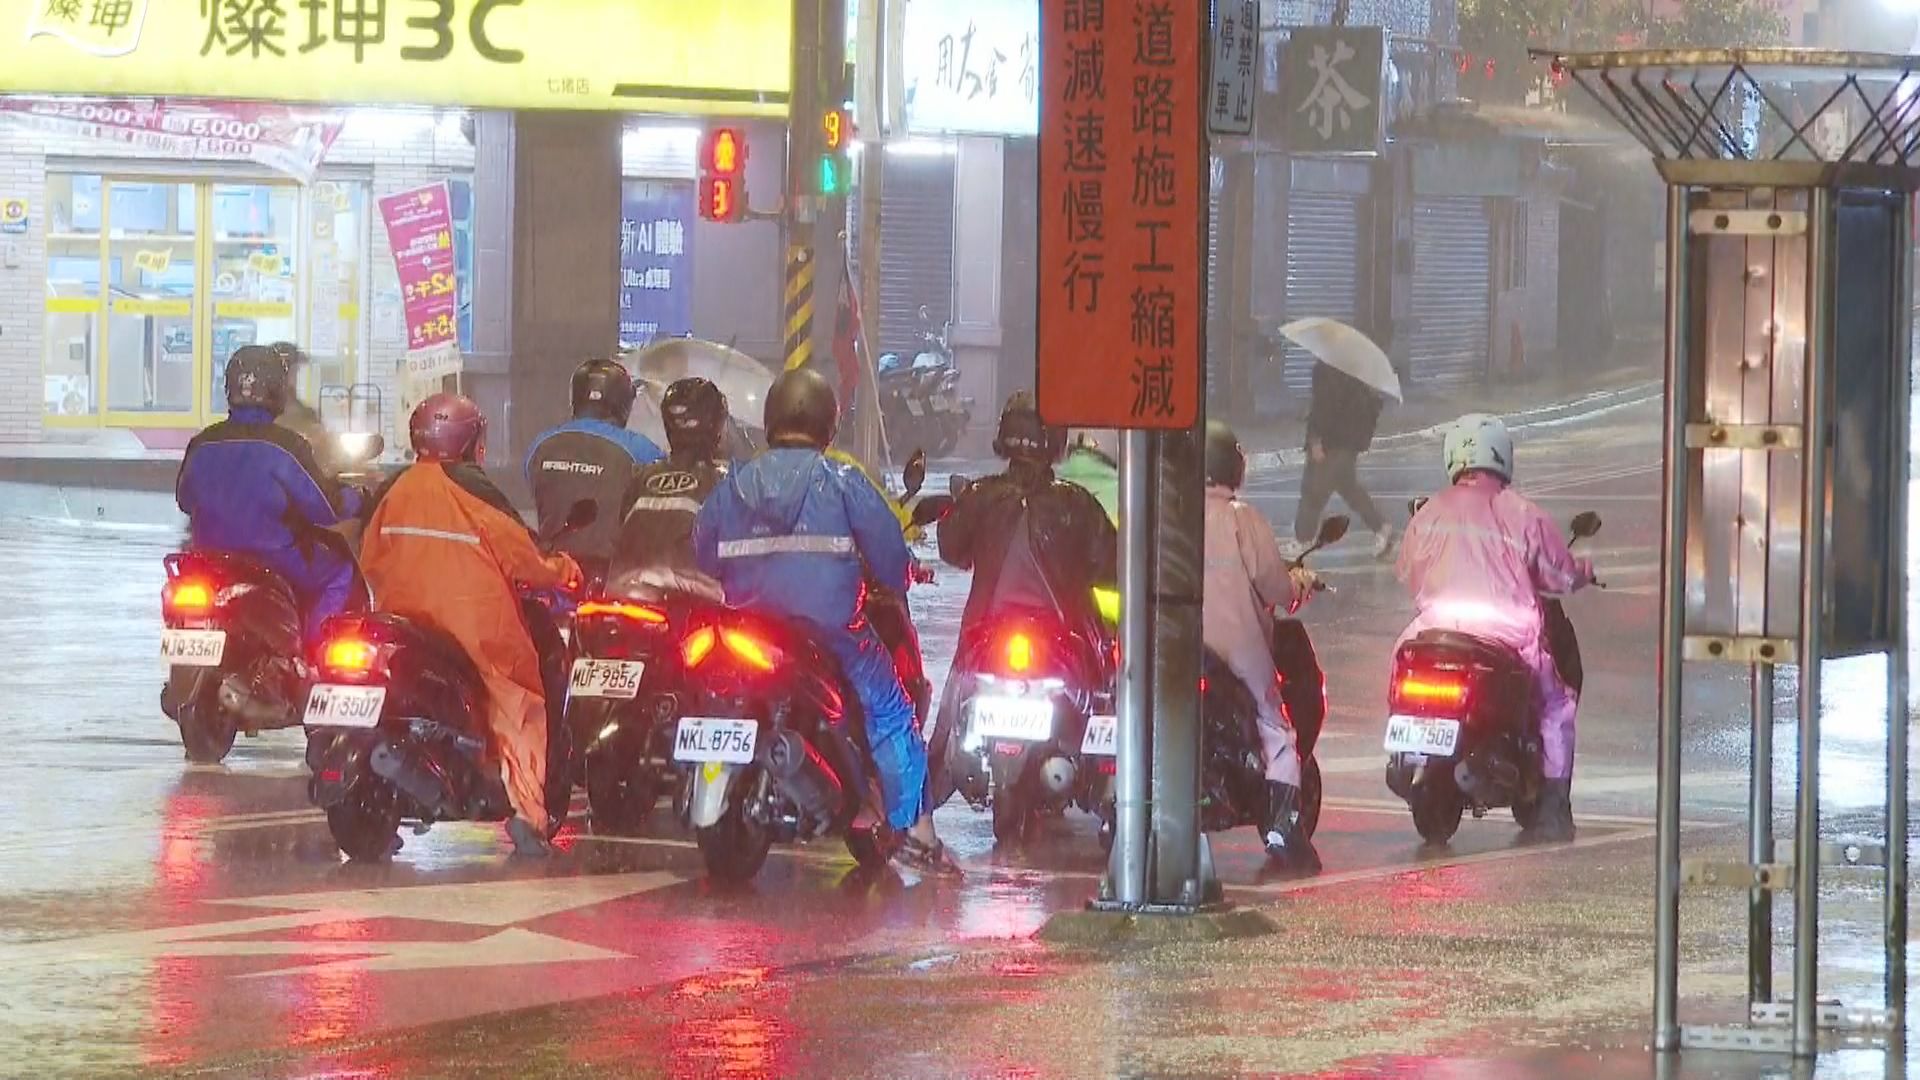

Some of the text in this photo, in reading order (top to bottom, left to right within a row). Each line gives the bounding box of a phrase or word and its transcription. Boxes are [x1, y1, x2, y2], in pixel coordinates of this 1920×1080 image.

[1296, 38, 1372, 141] 茶
[1130, 2, 1177, 417] 道路施工縮減
[678, 729, 753, 752] NKL-8756
